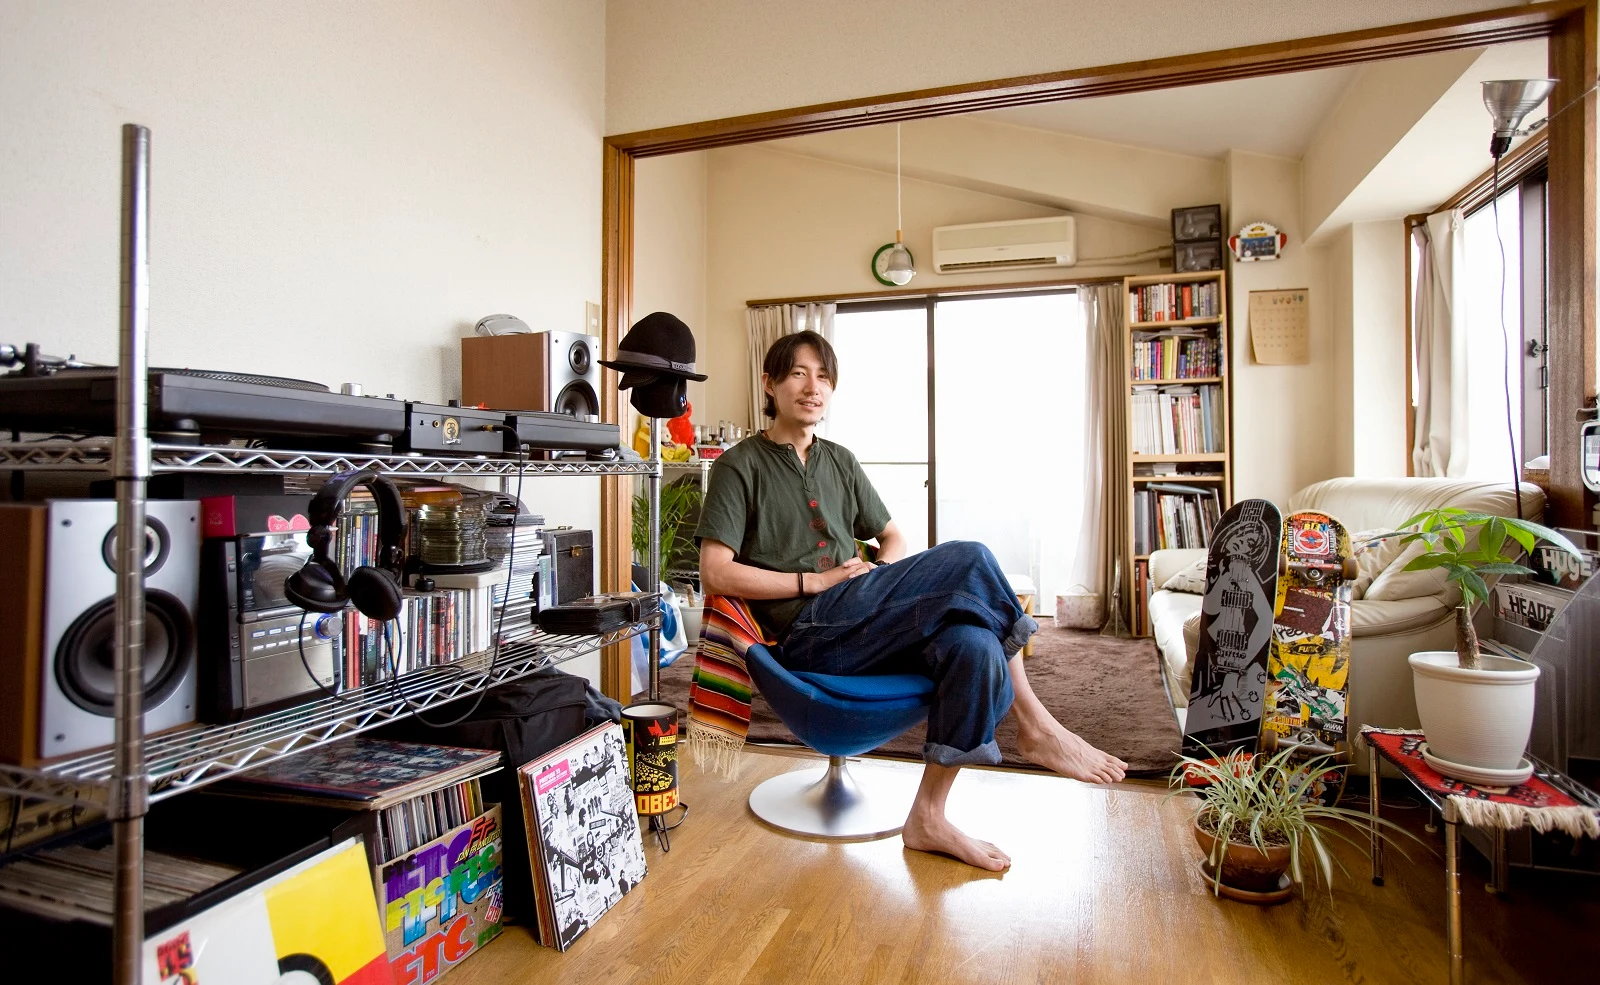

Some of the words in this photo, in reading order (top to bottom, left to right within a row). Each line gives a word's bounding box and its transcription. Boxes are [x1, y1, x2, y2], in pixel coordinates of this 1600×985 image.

[1508, 594, 1556, 624] HEADZ
[637, 789, 679, 815] OBEY
[389, 913, 475, 985] FTC
